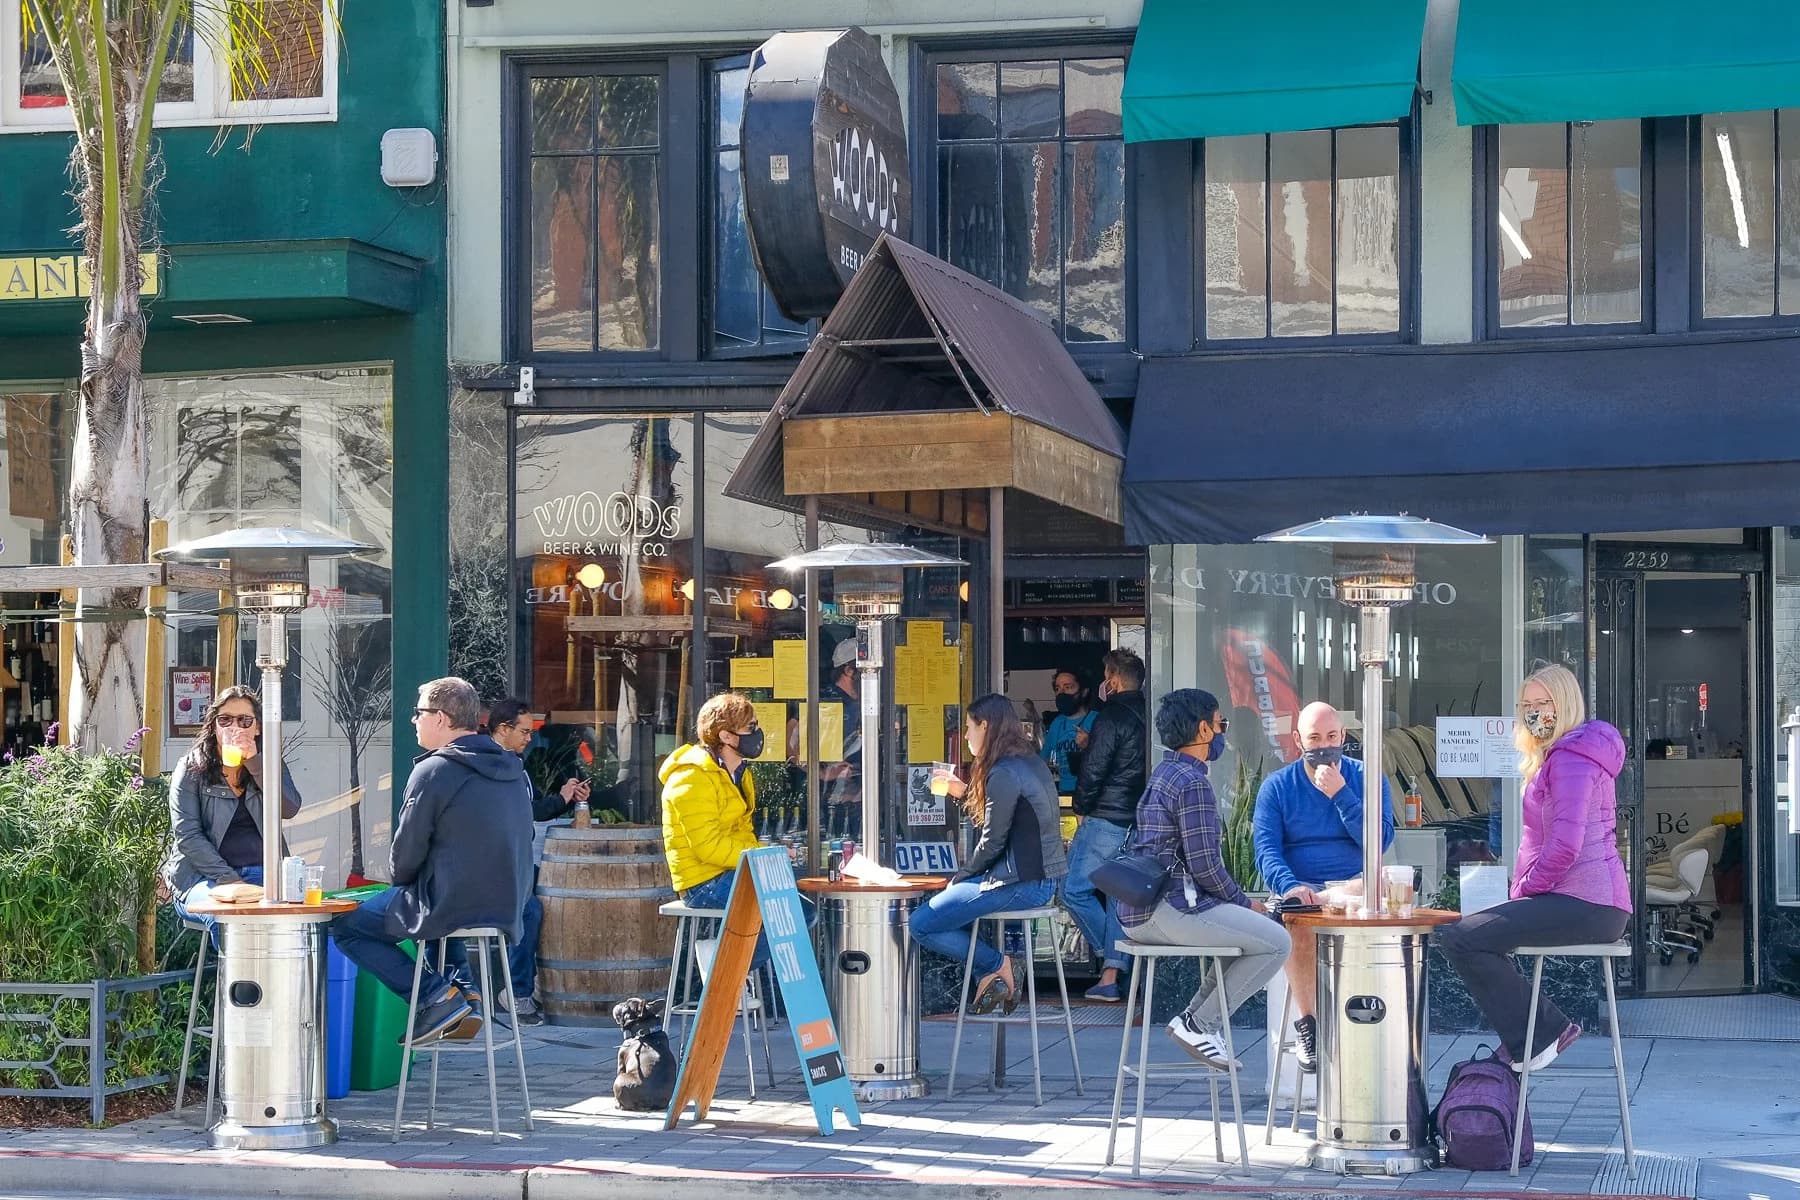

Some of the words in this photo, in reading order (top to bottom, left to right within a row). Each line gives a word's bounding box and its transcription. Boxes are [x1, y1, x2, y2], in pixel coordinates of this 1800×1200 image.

[828, 127, 898, 233] WOODS
[840, 244, 859, 273] BEER
[533, 490, 682, 539] WOODS
[543, 541, 581, 556] BEER
[583, 541, 597, 556] &
[599, 542, 639, 556] WINE
[1624, 551, 1669, 568] 2259
[1440, 752, 1449, 763] CO
[1459, 752, 1479, 763] SALON
[1656, 812, 1690, 835] Bé
[896, 845, 954, 871] OPEN
[752, 853, 796, 895] WOODS
[764, 896, 797, 939] POLK
